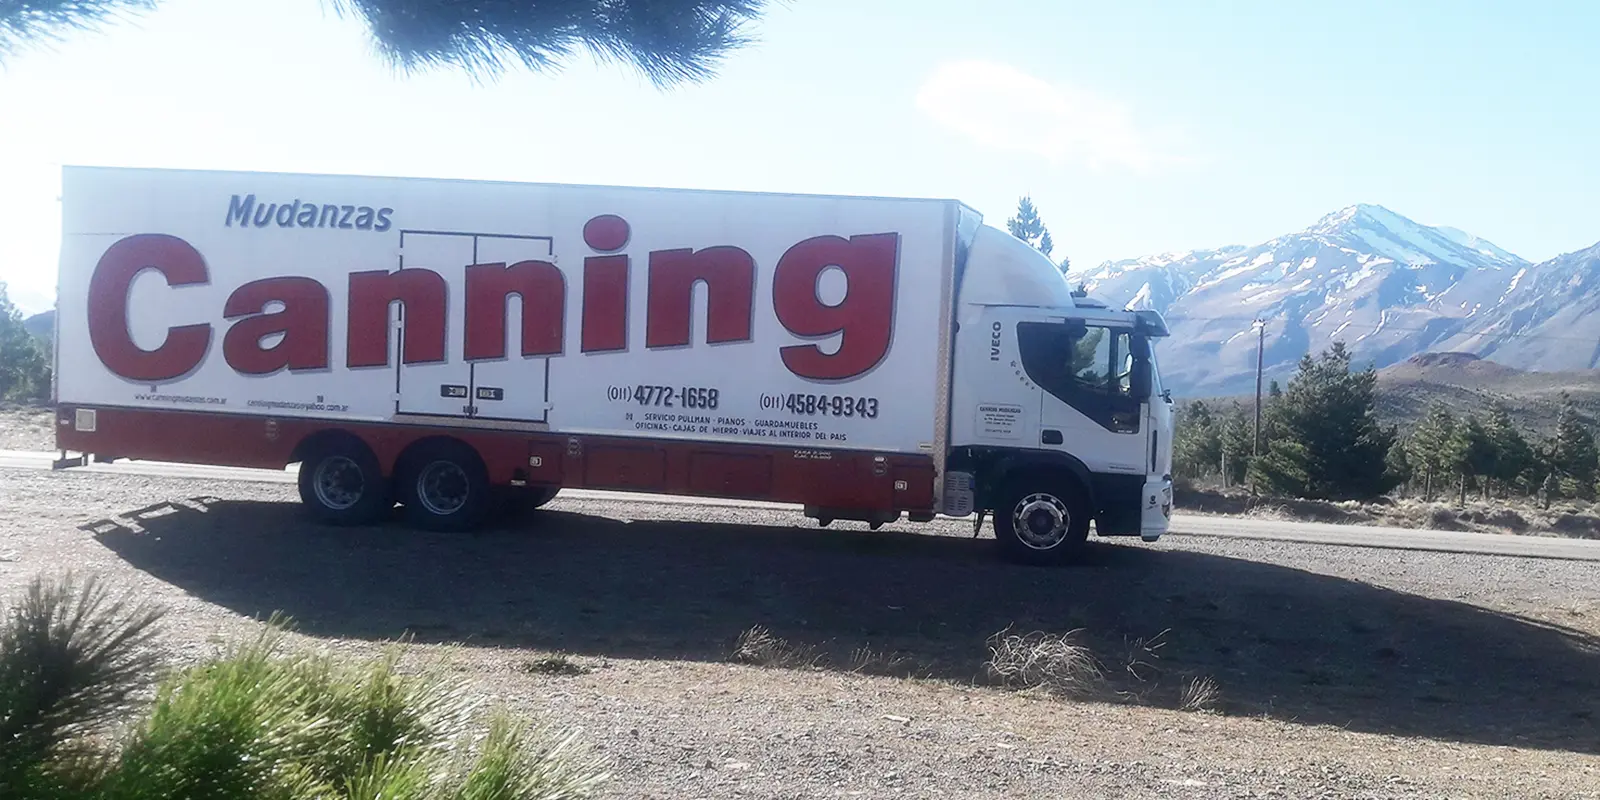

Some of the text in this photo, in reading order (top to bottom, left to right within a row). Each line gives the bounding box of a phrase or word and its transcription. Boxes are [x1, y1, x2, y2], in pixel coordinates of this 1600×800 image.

[225, 194, 394, 232] Mudanzas
[87, 214, 900, 385] Canning
[990, 321, 1002, 361] IVECO
[607, 385, 720, 410] (011) 4772-1658
[759, 392, 879, 419] (011) 4584-9343
[635, 422, 847, 441] OFICINAS CAJAS DE HIERRO VIAJES AL INTERIOR DEL PAIS
[644, 412, 818, 430] SERVICIO PULLMAN PIANOS GUARDAMUEBLES
